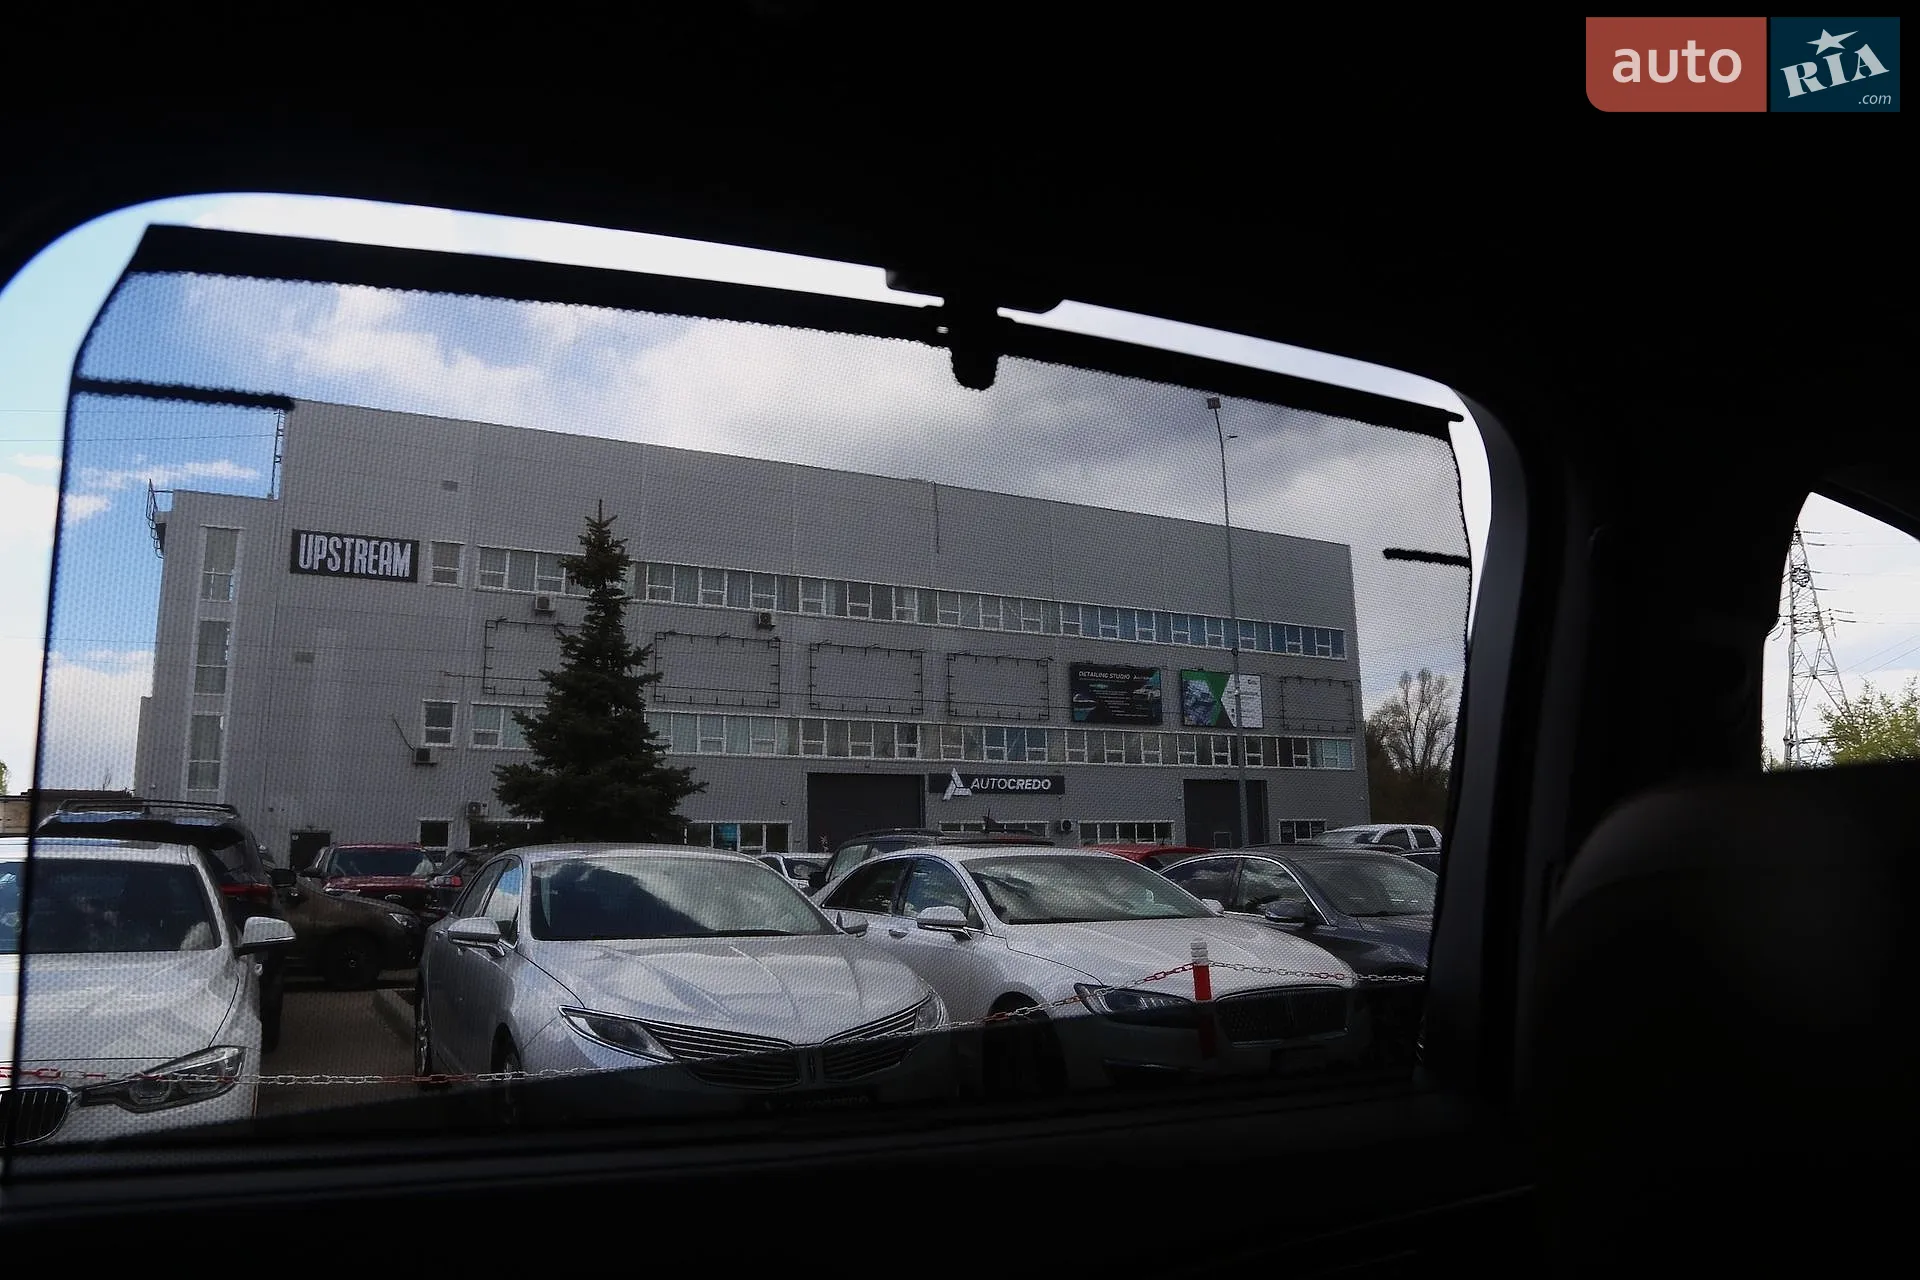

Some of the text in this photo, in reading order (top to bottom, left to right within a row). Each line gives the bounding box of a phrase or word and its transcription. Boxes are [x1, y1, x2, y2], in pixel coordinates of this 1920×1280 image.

[298, 534, 412, 577] UPSTREAM
[1078, 670, 1109, 679] DETAILING
[1109, 672, 1131, 680] STUDIO
[970, 778, 1052, 790] AUTOCREDO
